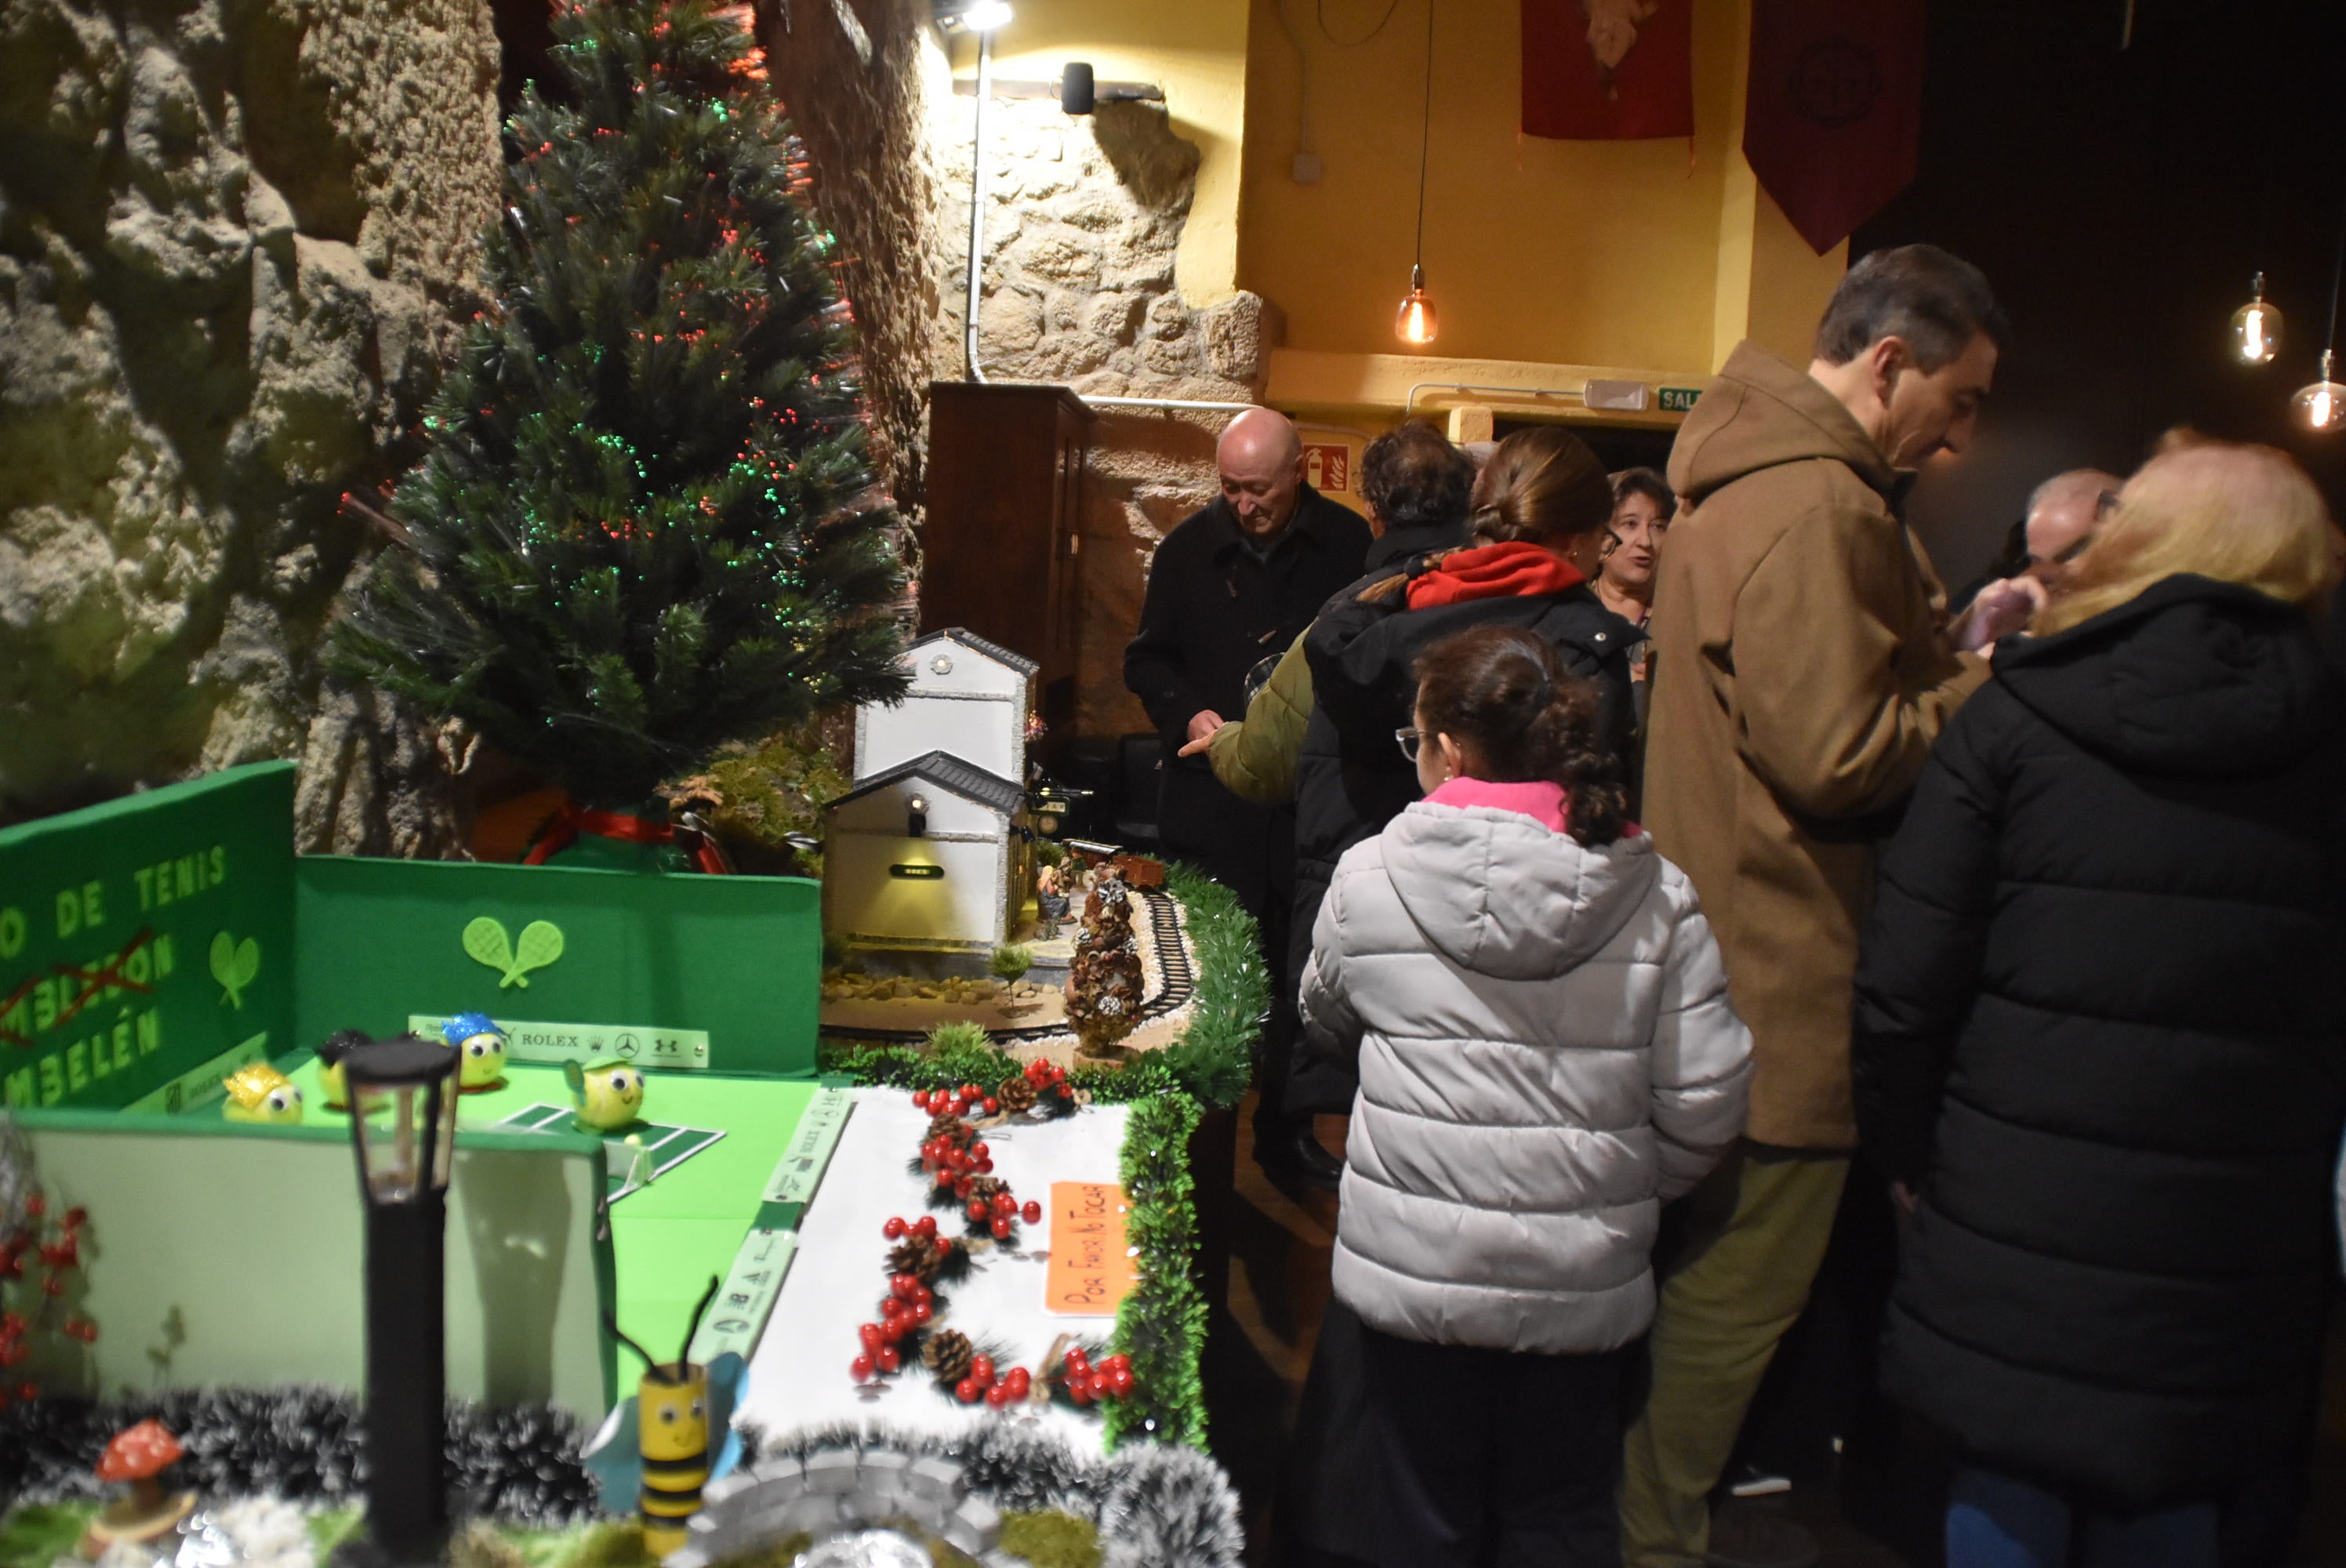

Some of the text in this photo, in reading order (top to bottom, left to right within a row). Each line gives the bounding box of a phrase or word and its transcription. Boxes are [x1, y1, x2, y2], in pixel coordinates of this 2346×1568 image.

[56, 880, 104, 940] DE
[134, 844, 226, 912] TENIS
[521, 1034, 579, 1048] ROLEX
